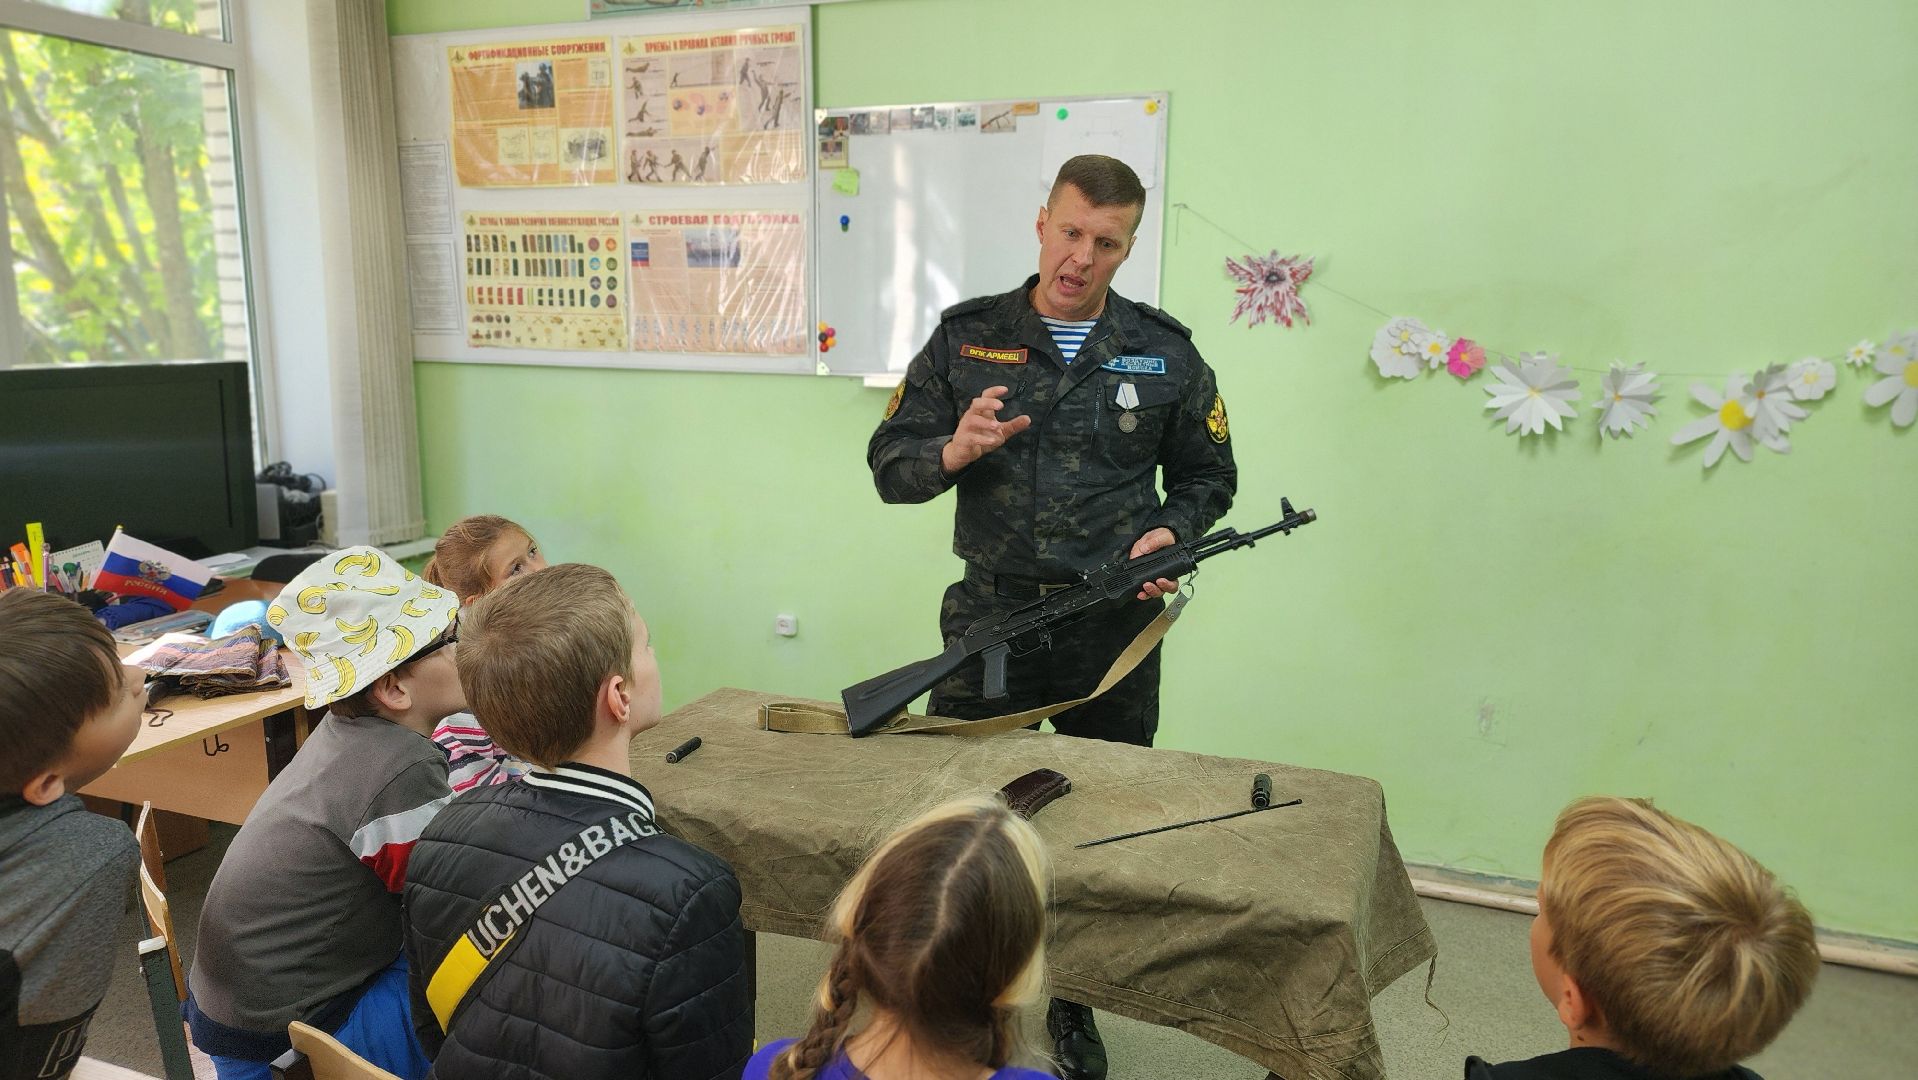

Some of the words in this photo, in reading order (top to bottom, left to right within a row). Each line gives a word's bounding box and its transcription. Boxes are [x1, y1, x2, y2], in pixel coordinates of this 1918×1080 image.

[648, 215, 708, 225] СТРОЕВАЯ
[986, 351, 1019, 361] АРМЕЕЦ
[467, 812, 661, 957] UCHEN&BAG
